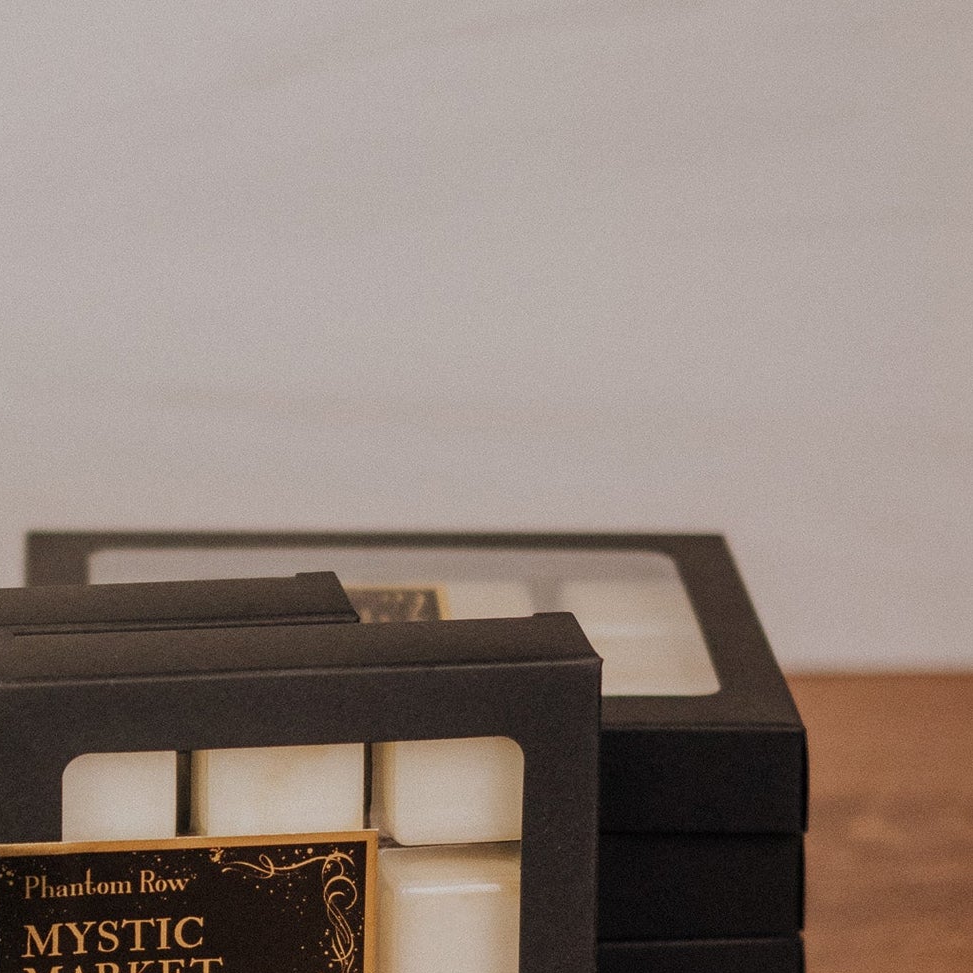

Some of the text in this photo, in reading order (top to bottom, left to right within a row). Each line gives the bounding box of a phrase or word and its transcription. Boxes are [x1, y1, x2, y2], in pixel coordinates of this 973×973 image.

[25, 868, 190, 899] Phantom Row
[22, 916, 205, 958] MYSTIC
